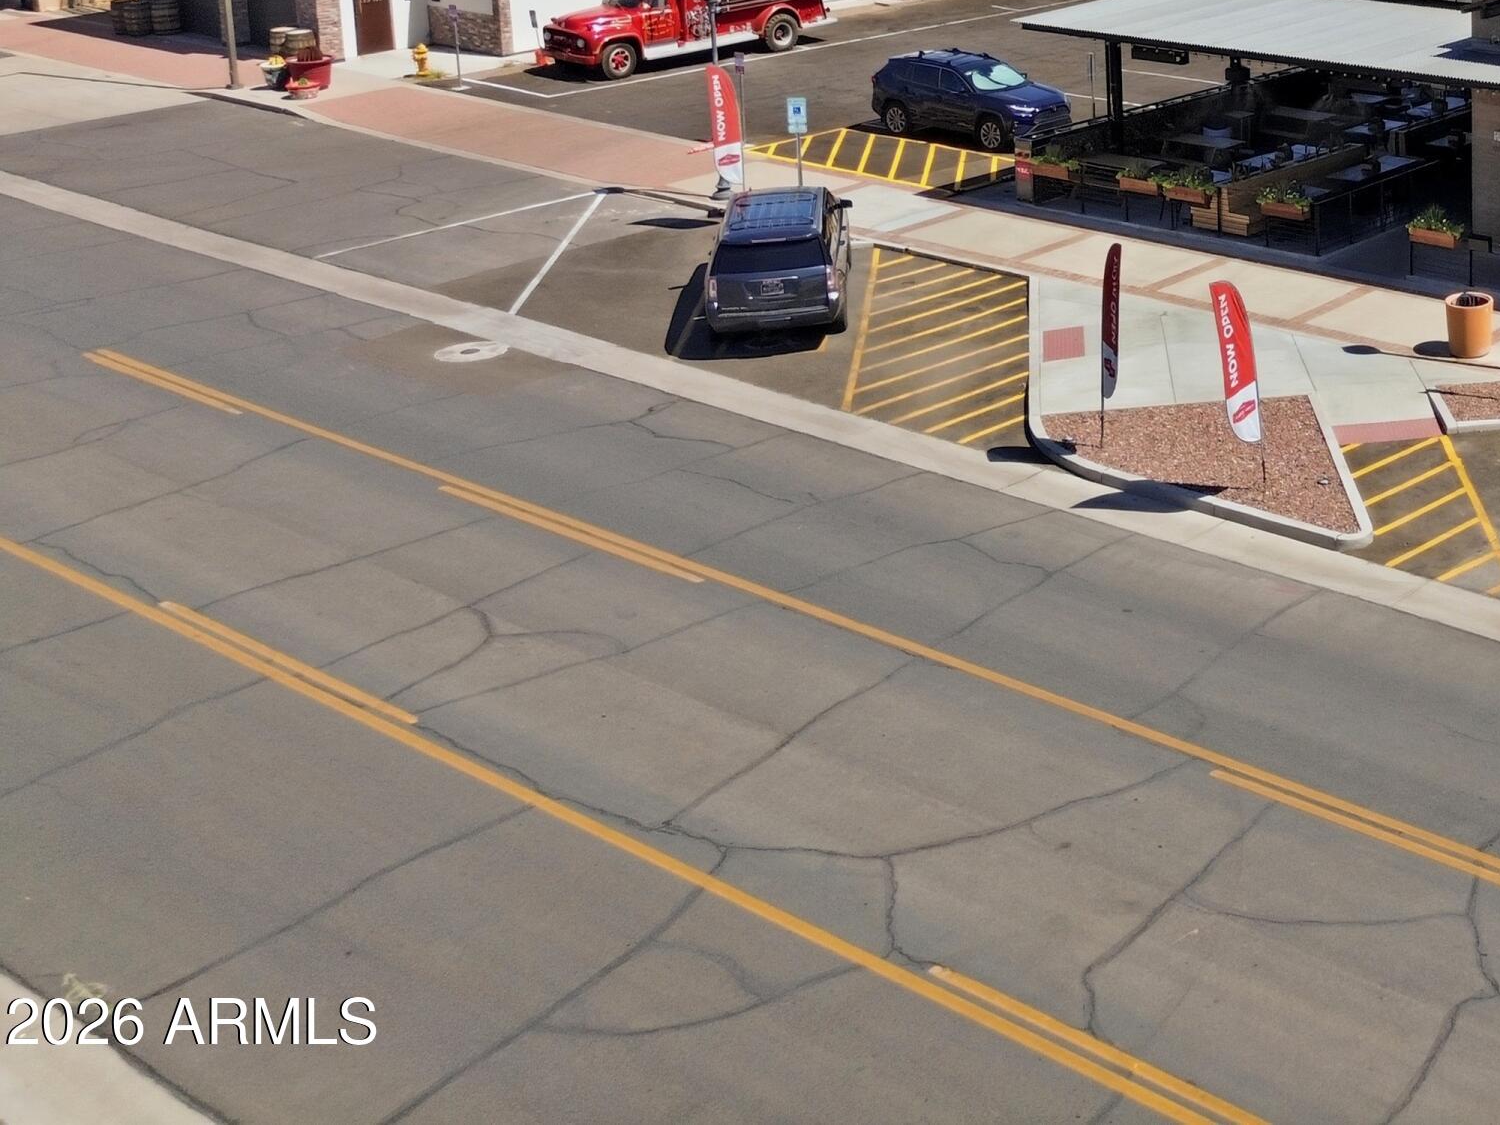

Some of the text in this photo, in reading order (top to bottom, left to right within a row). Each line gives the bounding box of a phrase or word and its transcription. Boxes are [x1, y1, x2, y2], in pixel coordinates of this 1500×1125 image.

[711, 74, 726, 141] NOW OPEN
[1109, 301, 1118, 346] OPEN
[1218, 294, 1239, 388] NOW OPEN
